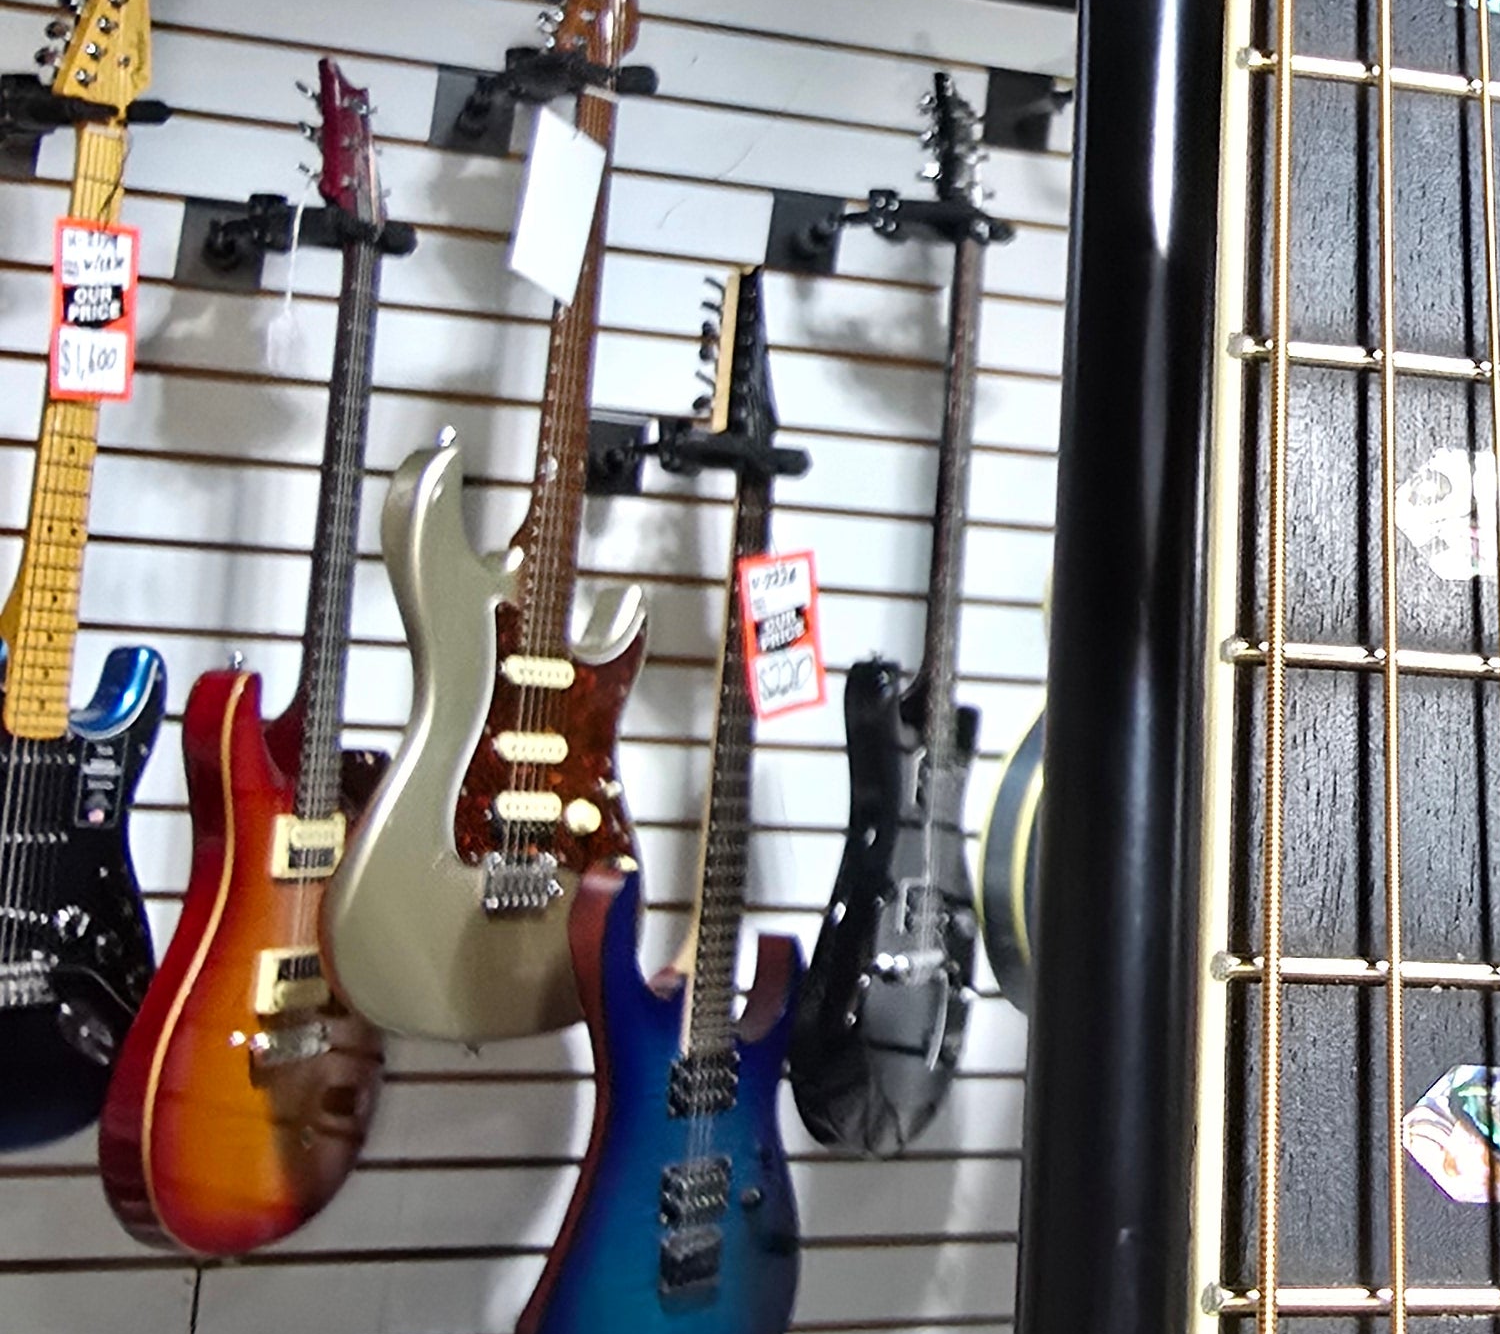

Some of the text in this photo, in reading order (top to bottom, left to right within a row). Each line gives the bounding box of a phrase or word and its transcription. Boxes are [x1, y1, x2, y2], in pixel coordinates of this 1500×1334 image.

[73, 287, 113, 304] OUR
[67, 300, 122, 322] PRICE
[764, 609, 797, 633] OUR
[760, 622, 806, 652] PRICE
